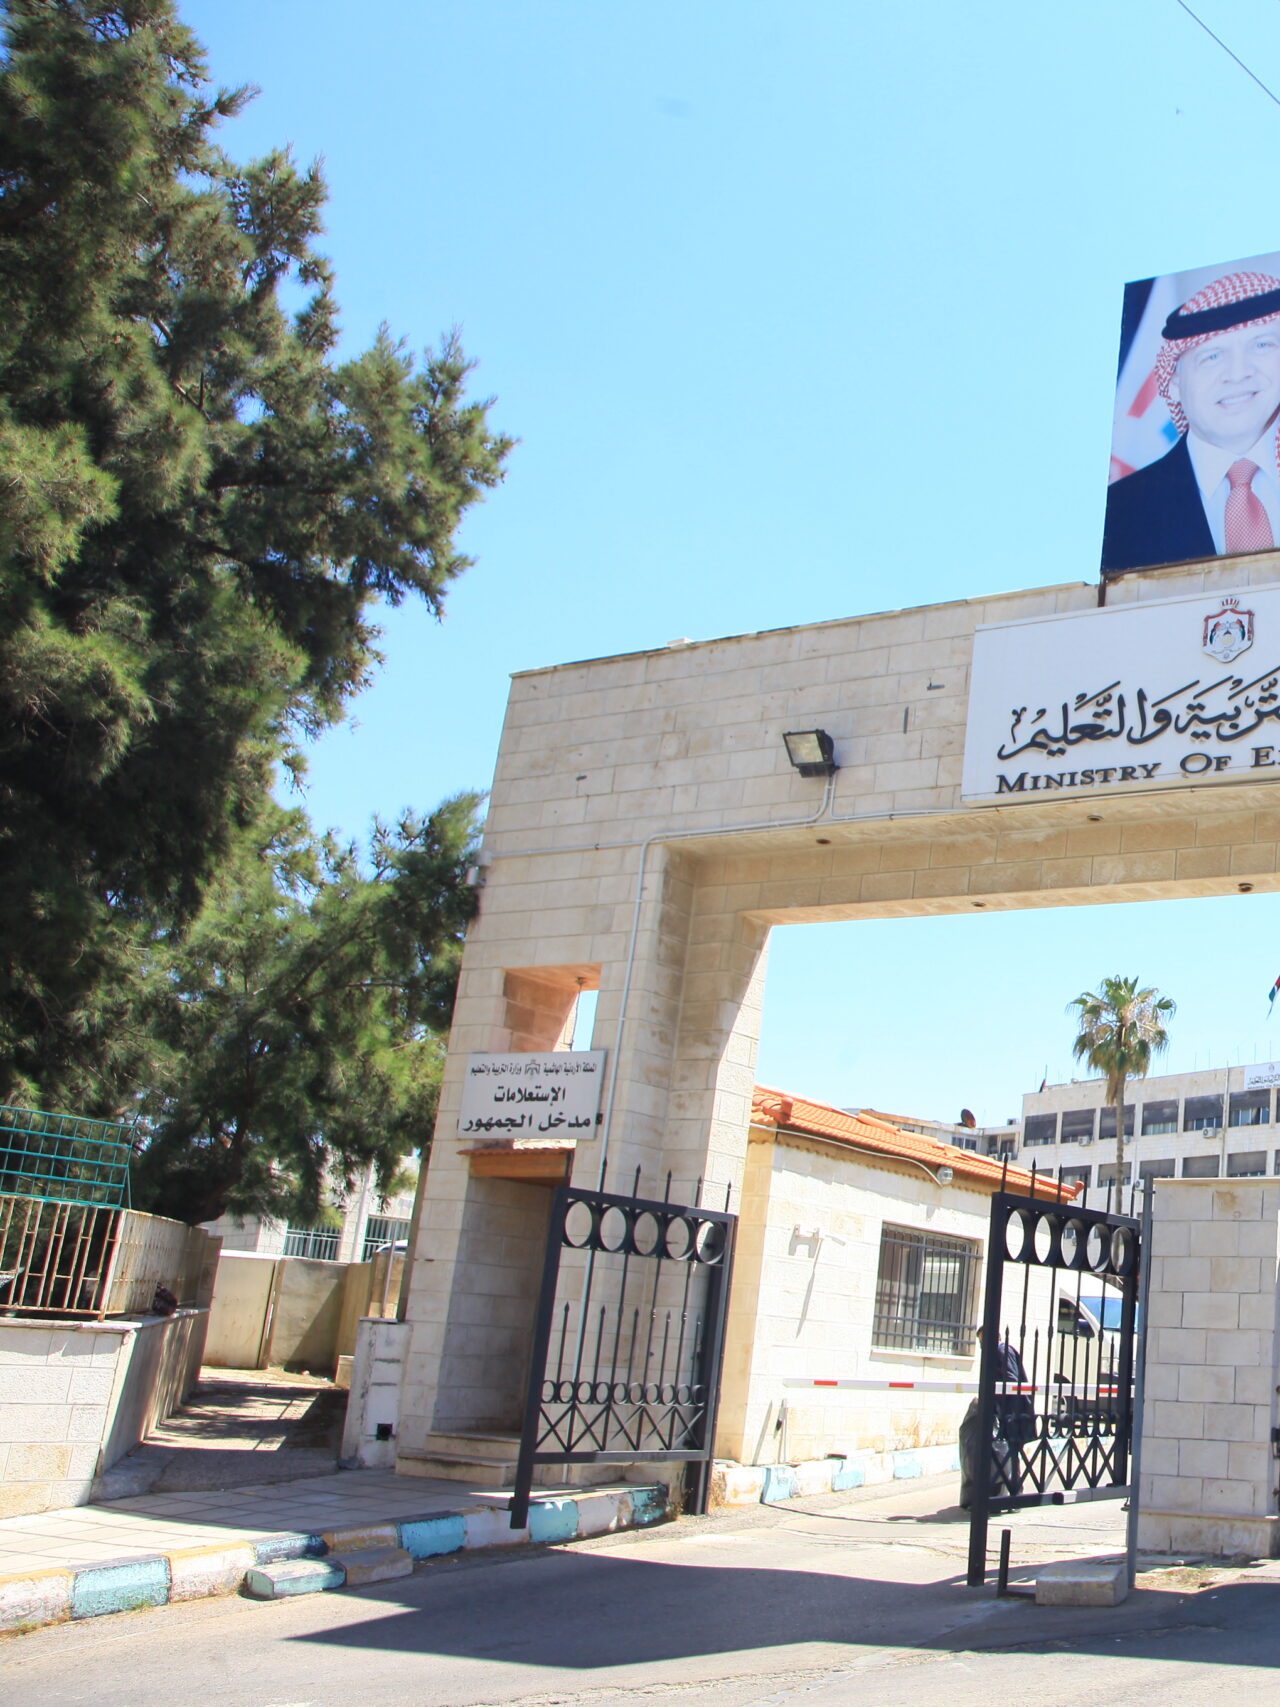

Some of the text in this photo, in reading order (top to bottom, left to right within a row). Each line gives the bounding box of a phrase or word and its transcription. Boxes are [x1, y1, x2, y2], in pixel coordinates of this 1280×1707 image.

[994, 762, 1162, 795] MINISTRY
[1179, 752, 1233, 775] OF
[493, 1085, 566, 1106] الإستعلامات
[462, 1112, 590, 1132] مدخل الجمهور
